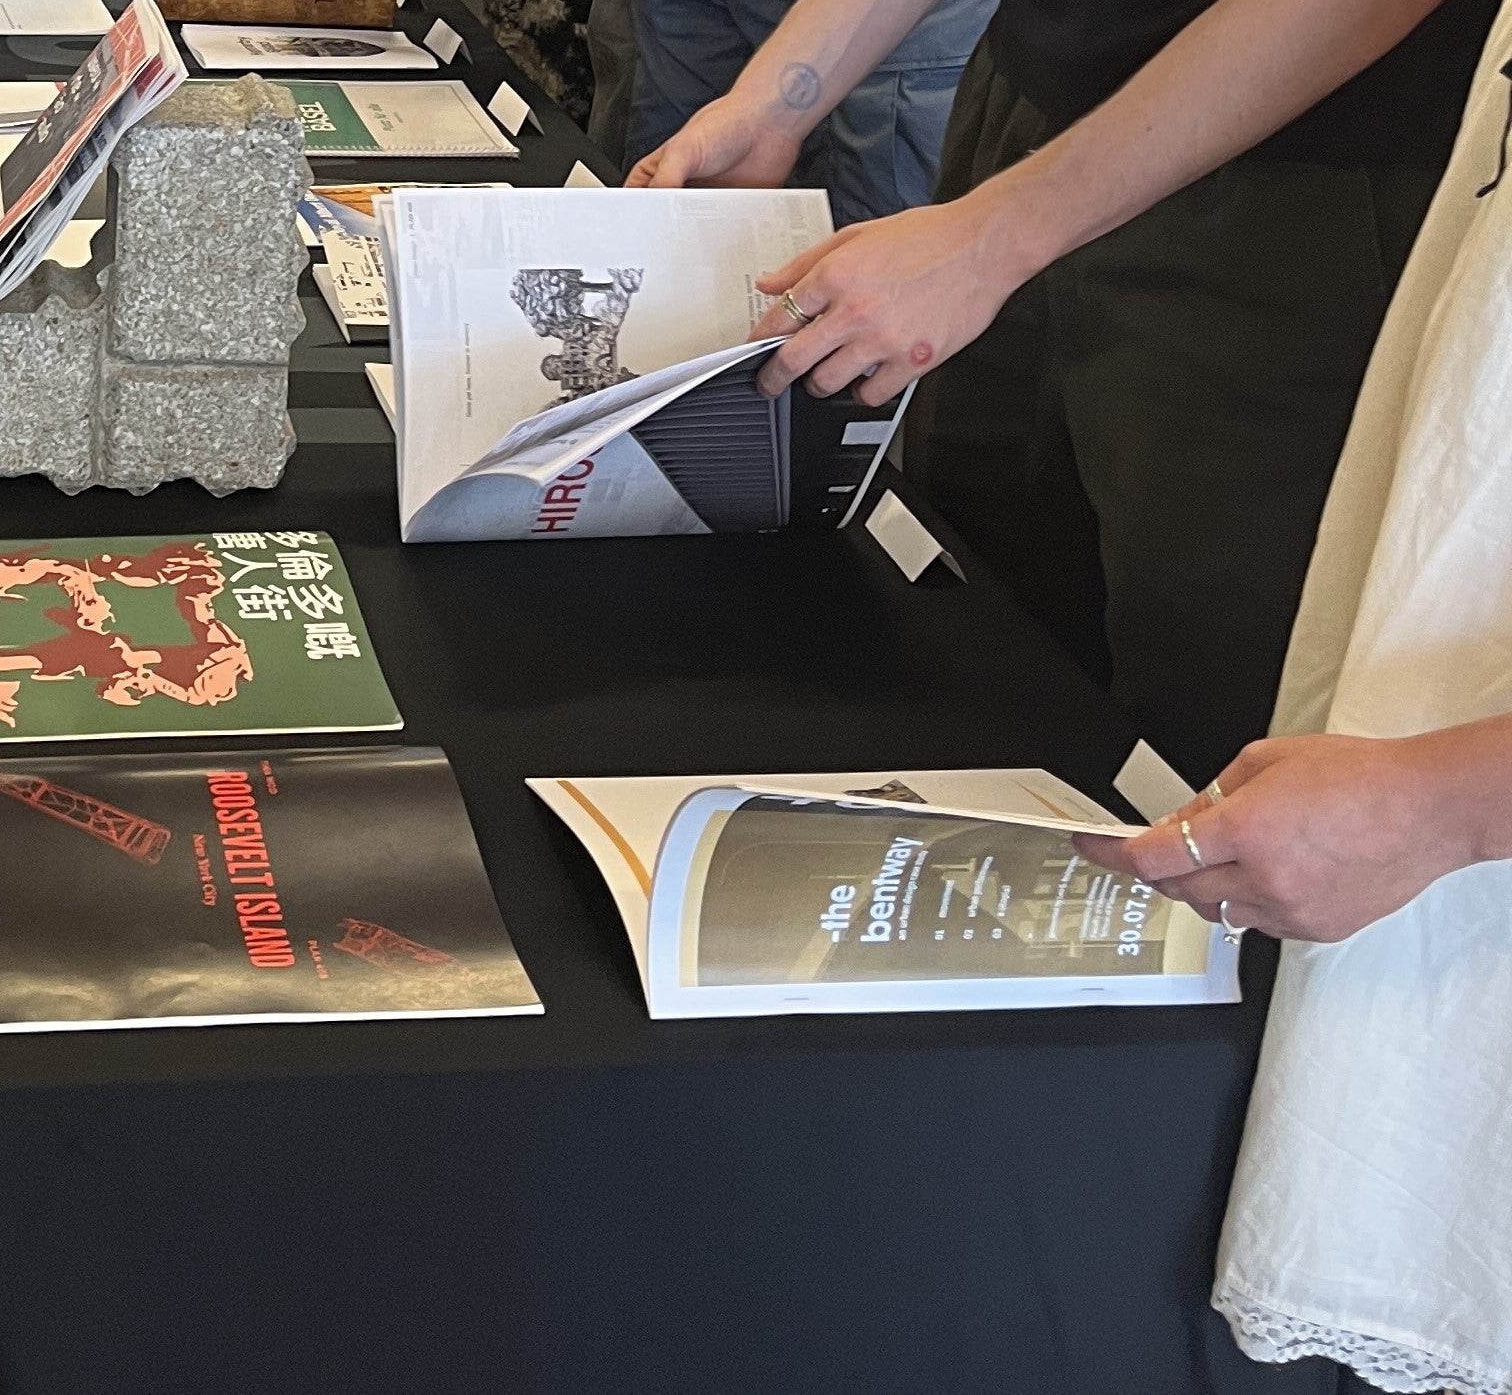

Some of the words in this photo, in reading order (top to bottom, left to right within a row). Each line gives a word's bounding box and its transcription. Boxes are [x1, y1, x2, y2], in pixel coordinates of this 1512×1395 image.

[300, 102, 336, 131] BASEL
[206, 769, 275, 888] ROOSEVELT
[192, 834, 206, 857] New
[197, 858, 214, 882] York
[201, 883, 218, 906] City
[860, 837, 924, 942] bentway
[903, 881, 919, 905] design
[899, 905, 912, 929] urban
[233, 893, 296, 967] ISLAND
[934, 929, 946, 940] 01
